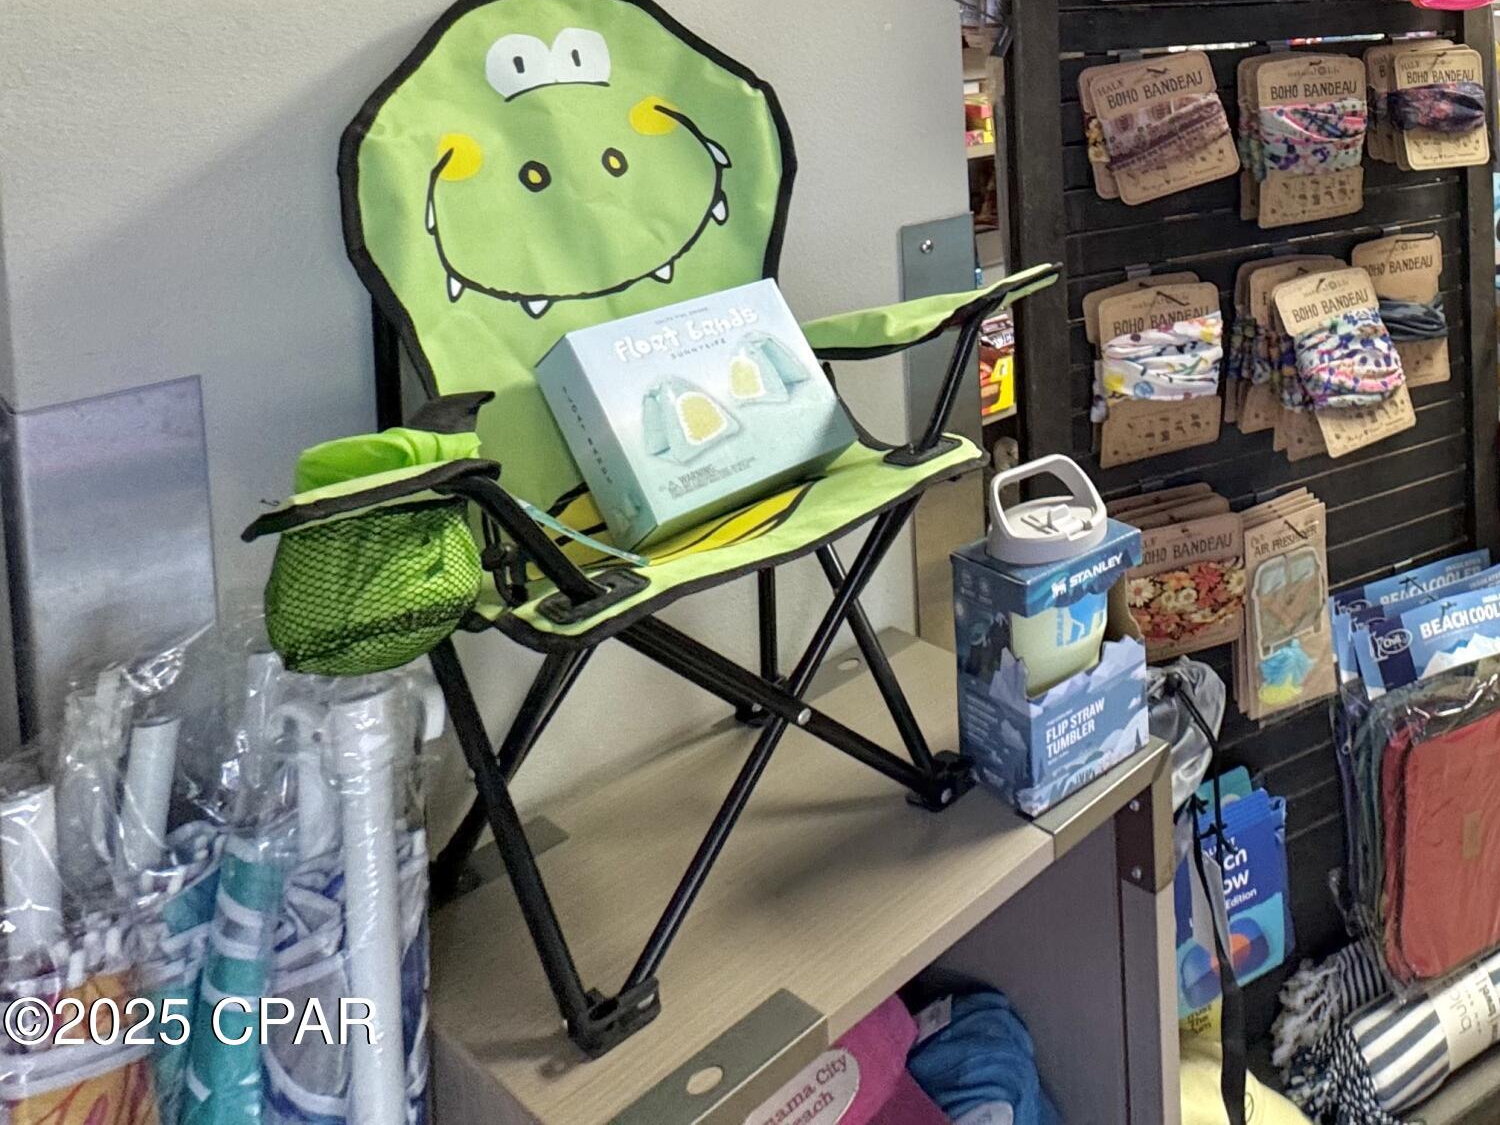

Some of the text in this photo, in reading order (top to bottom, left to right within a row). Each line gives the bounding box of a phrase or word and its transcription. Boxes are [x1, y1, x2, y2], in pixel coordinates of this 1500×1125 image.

[1107, 70, 1203, 109] BOHO BANDEAU
[1270, 81, 1358, 101] BOHO BANDEAU
[1406, 69, 1475, 84] BOHO BANDEAU
[1389, 254, 1434, 275] BANDEAU
[1292, 289, 1370, 324] BOHO BANDEAU
[1112, 317, 1144, 337] BOHO
[1173, 531, 1234, 560] BANDEAU
[1253, 541, 1270, 558] AIR
[1069, 552, 1124, 589] STANLEY
[1419, 612, 1470, 640] BEACH
[1046, 718, 1068, 743] FLIP
[1070, 698, 1106, 727] STRAW
[1046, 718, 1096, 759] TUMBLER
[816, 1053, 848, 1085] City
